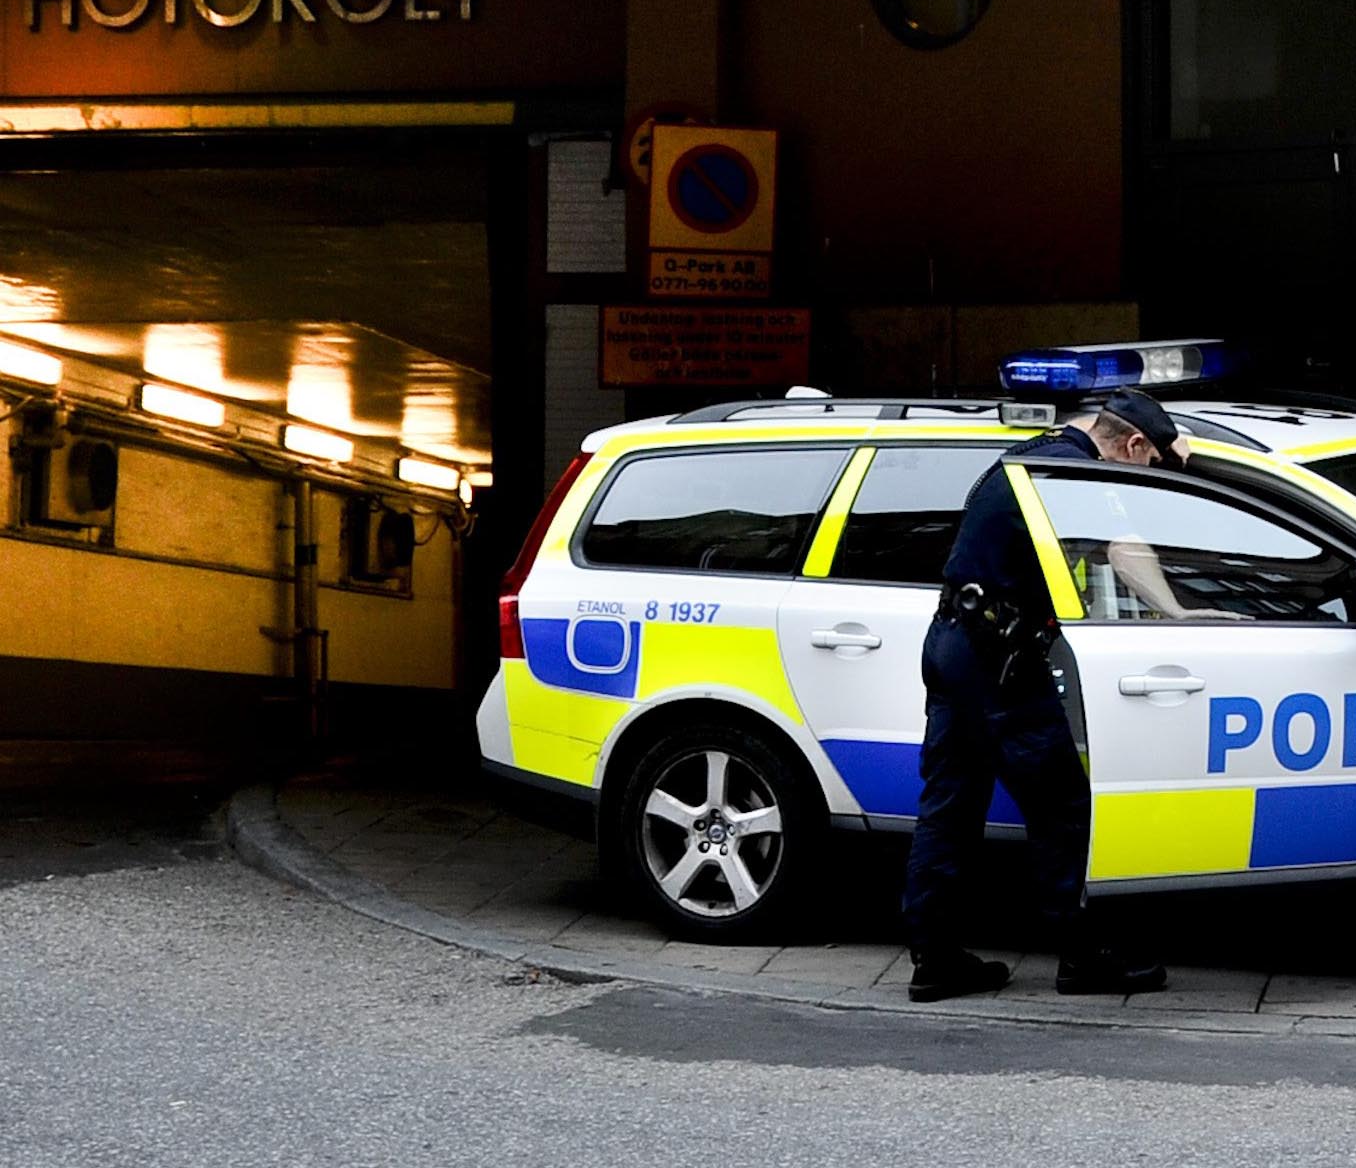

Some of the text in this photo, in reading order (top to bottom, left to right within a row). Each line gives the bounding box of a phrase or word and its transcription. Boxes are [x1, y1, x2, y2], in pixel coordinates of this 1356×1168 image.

[665, 259, 725, 273] Q-Park
[577, 600, 626, 616] ETANOL
[645, 600, 720, 624] 8 1937
